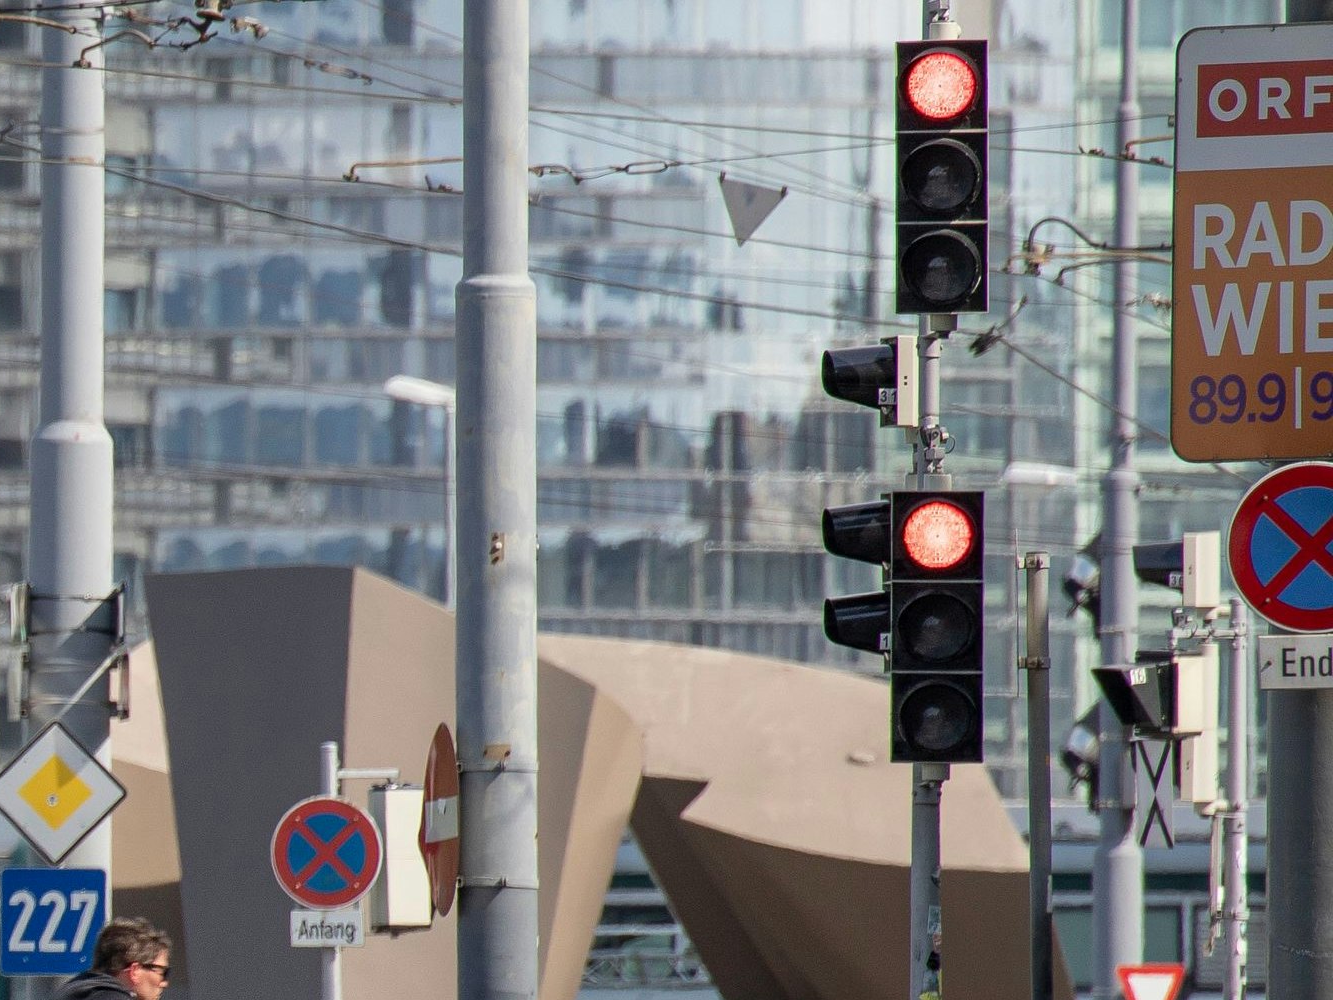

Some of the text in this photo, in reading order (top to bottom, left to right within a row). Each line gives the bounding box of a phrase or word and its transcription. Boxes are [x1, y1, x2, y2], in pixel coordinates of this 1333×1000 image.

[1208, 76, 1333, 122] ORF
[1193, 200, 1333, 270] RAD
[1190, 280, 1333, 357] WIE
[1282, 648, 1333, 677] End
[8, 889, 98, 953] 227
[297, 919, 356, 944] Anfang
